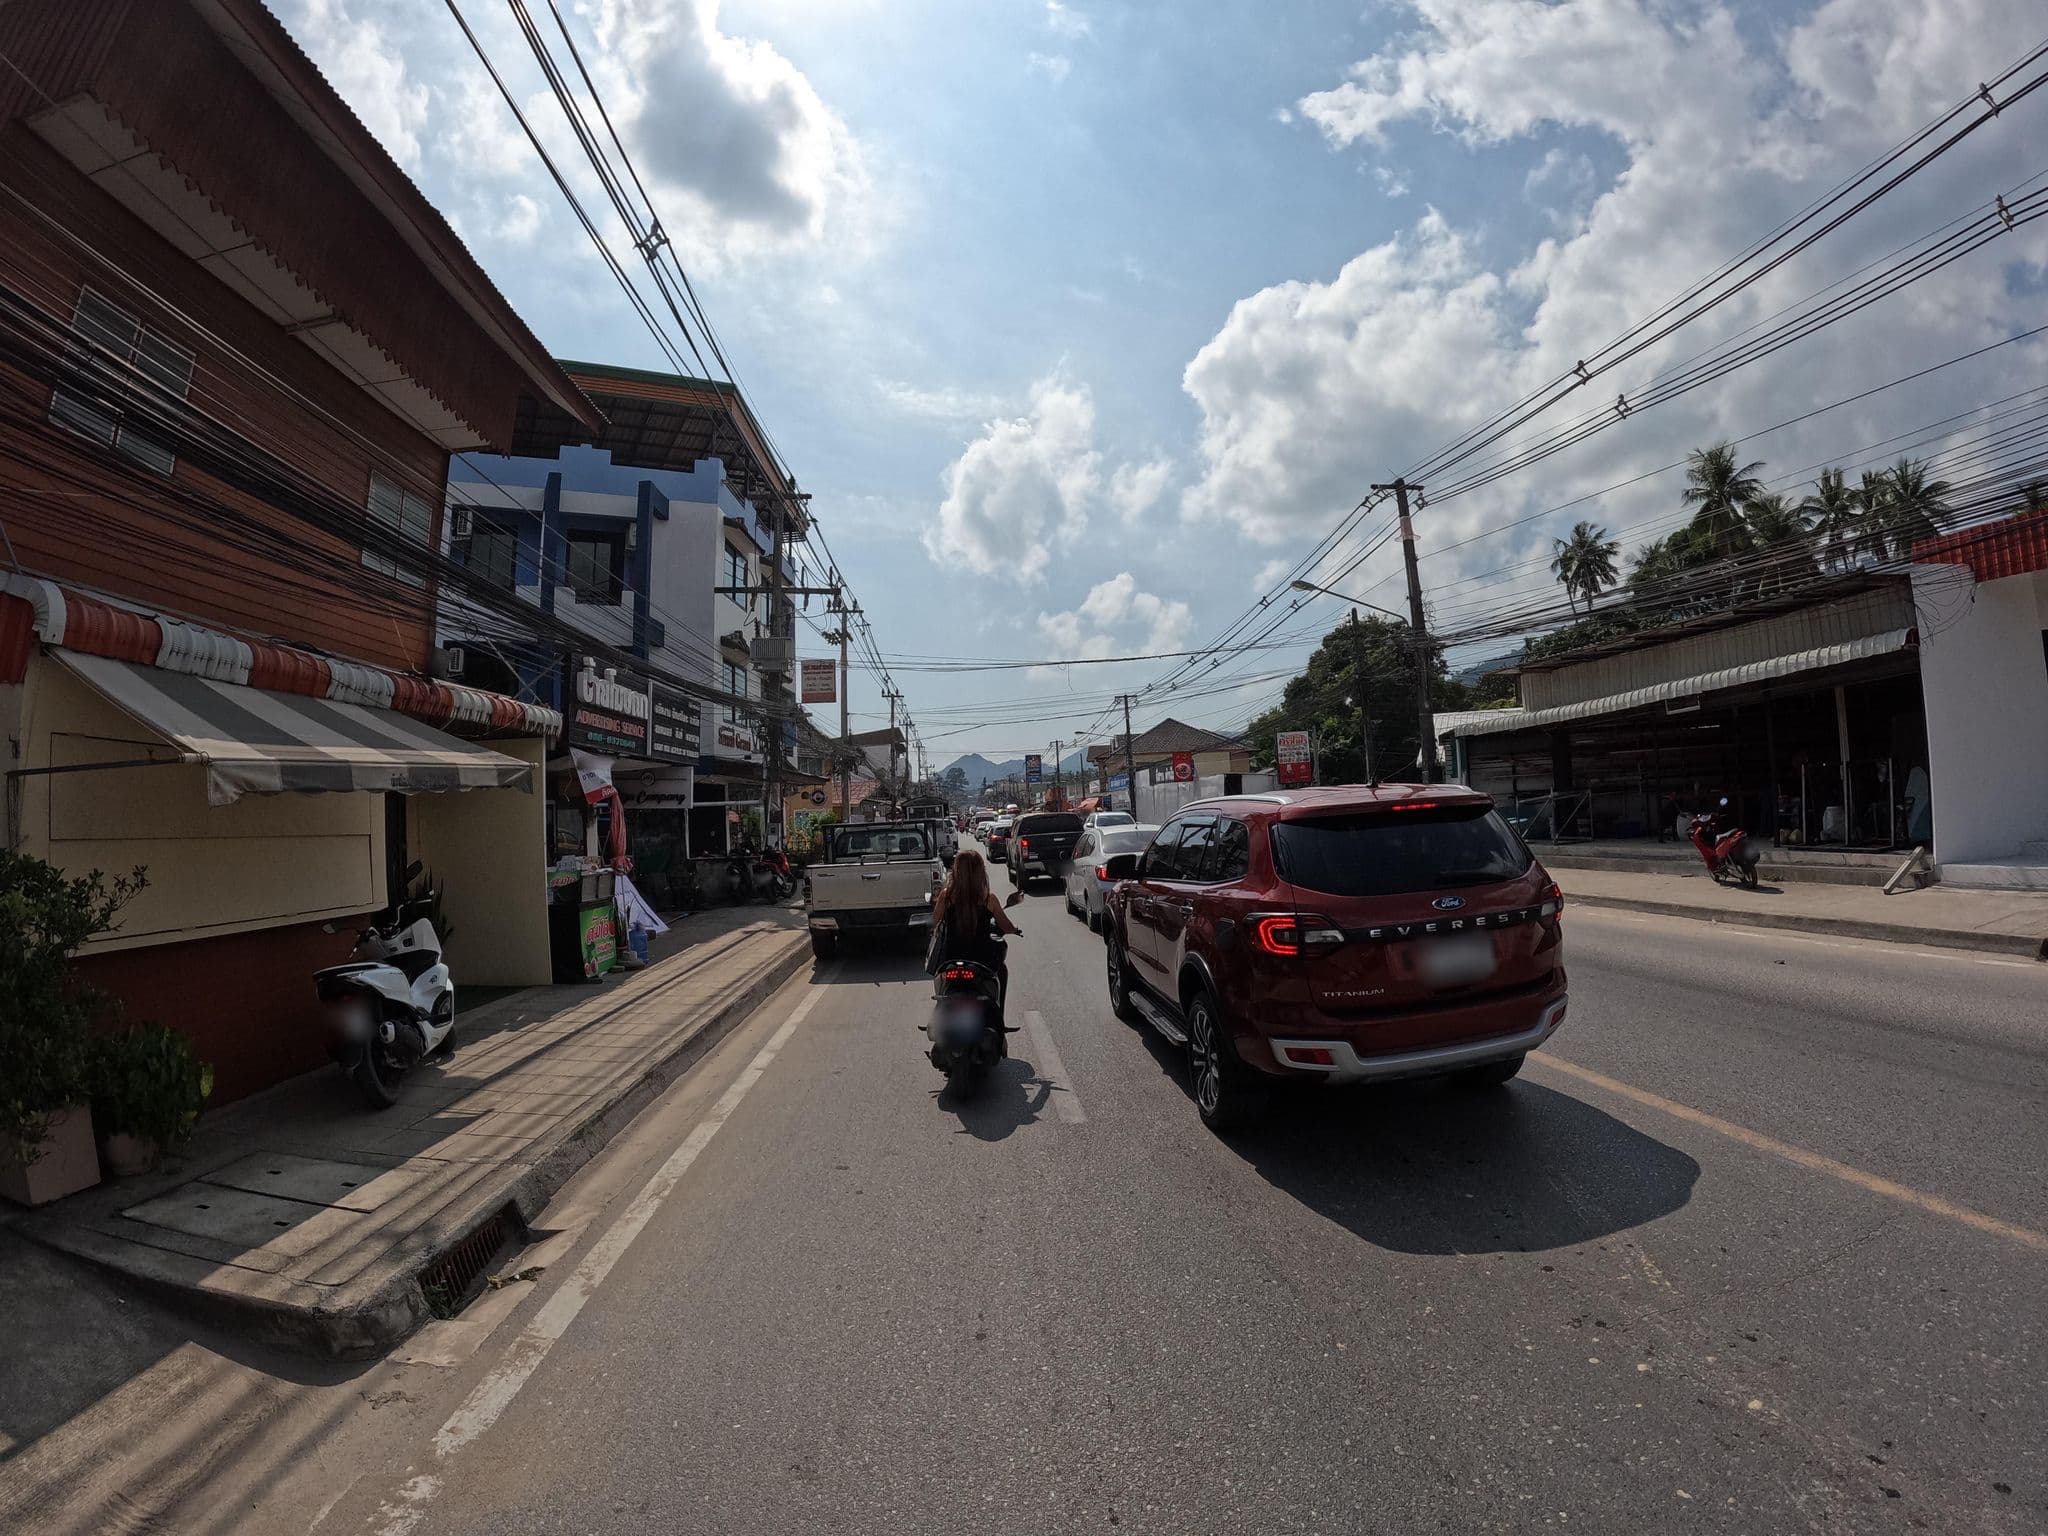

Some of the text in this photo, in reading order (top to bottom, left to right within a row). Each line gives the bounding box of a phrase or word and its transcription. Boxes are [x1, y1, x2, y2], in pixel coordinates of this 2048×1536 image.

[575, 709, 621, 733] ADVERTISING
[621, 721, 645, 738] SERVICE
[637, 791, 686, 806] Company
[1438, 897, 1464, 909] Ford
[1369, 910, 1530, 939] EVEREST
[1322, 988, 1385, 998] TITANIUM
